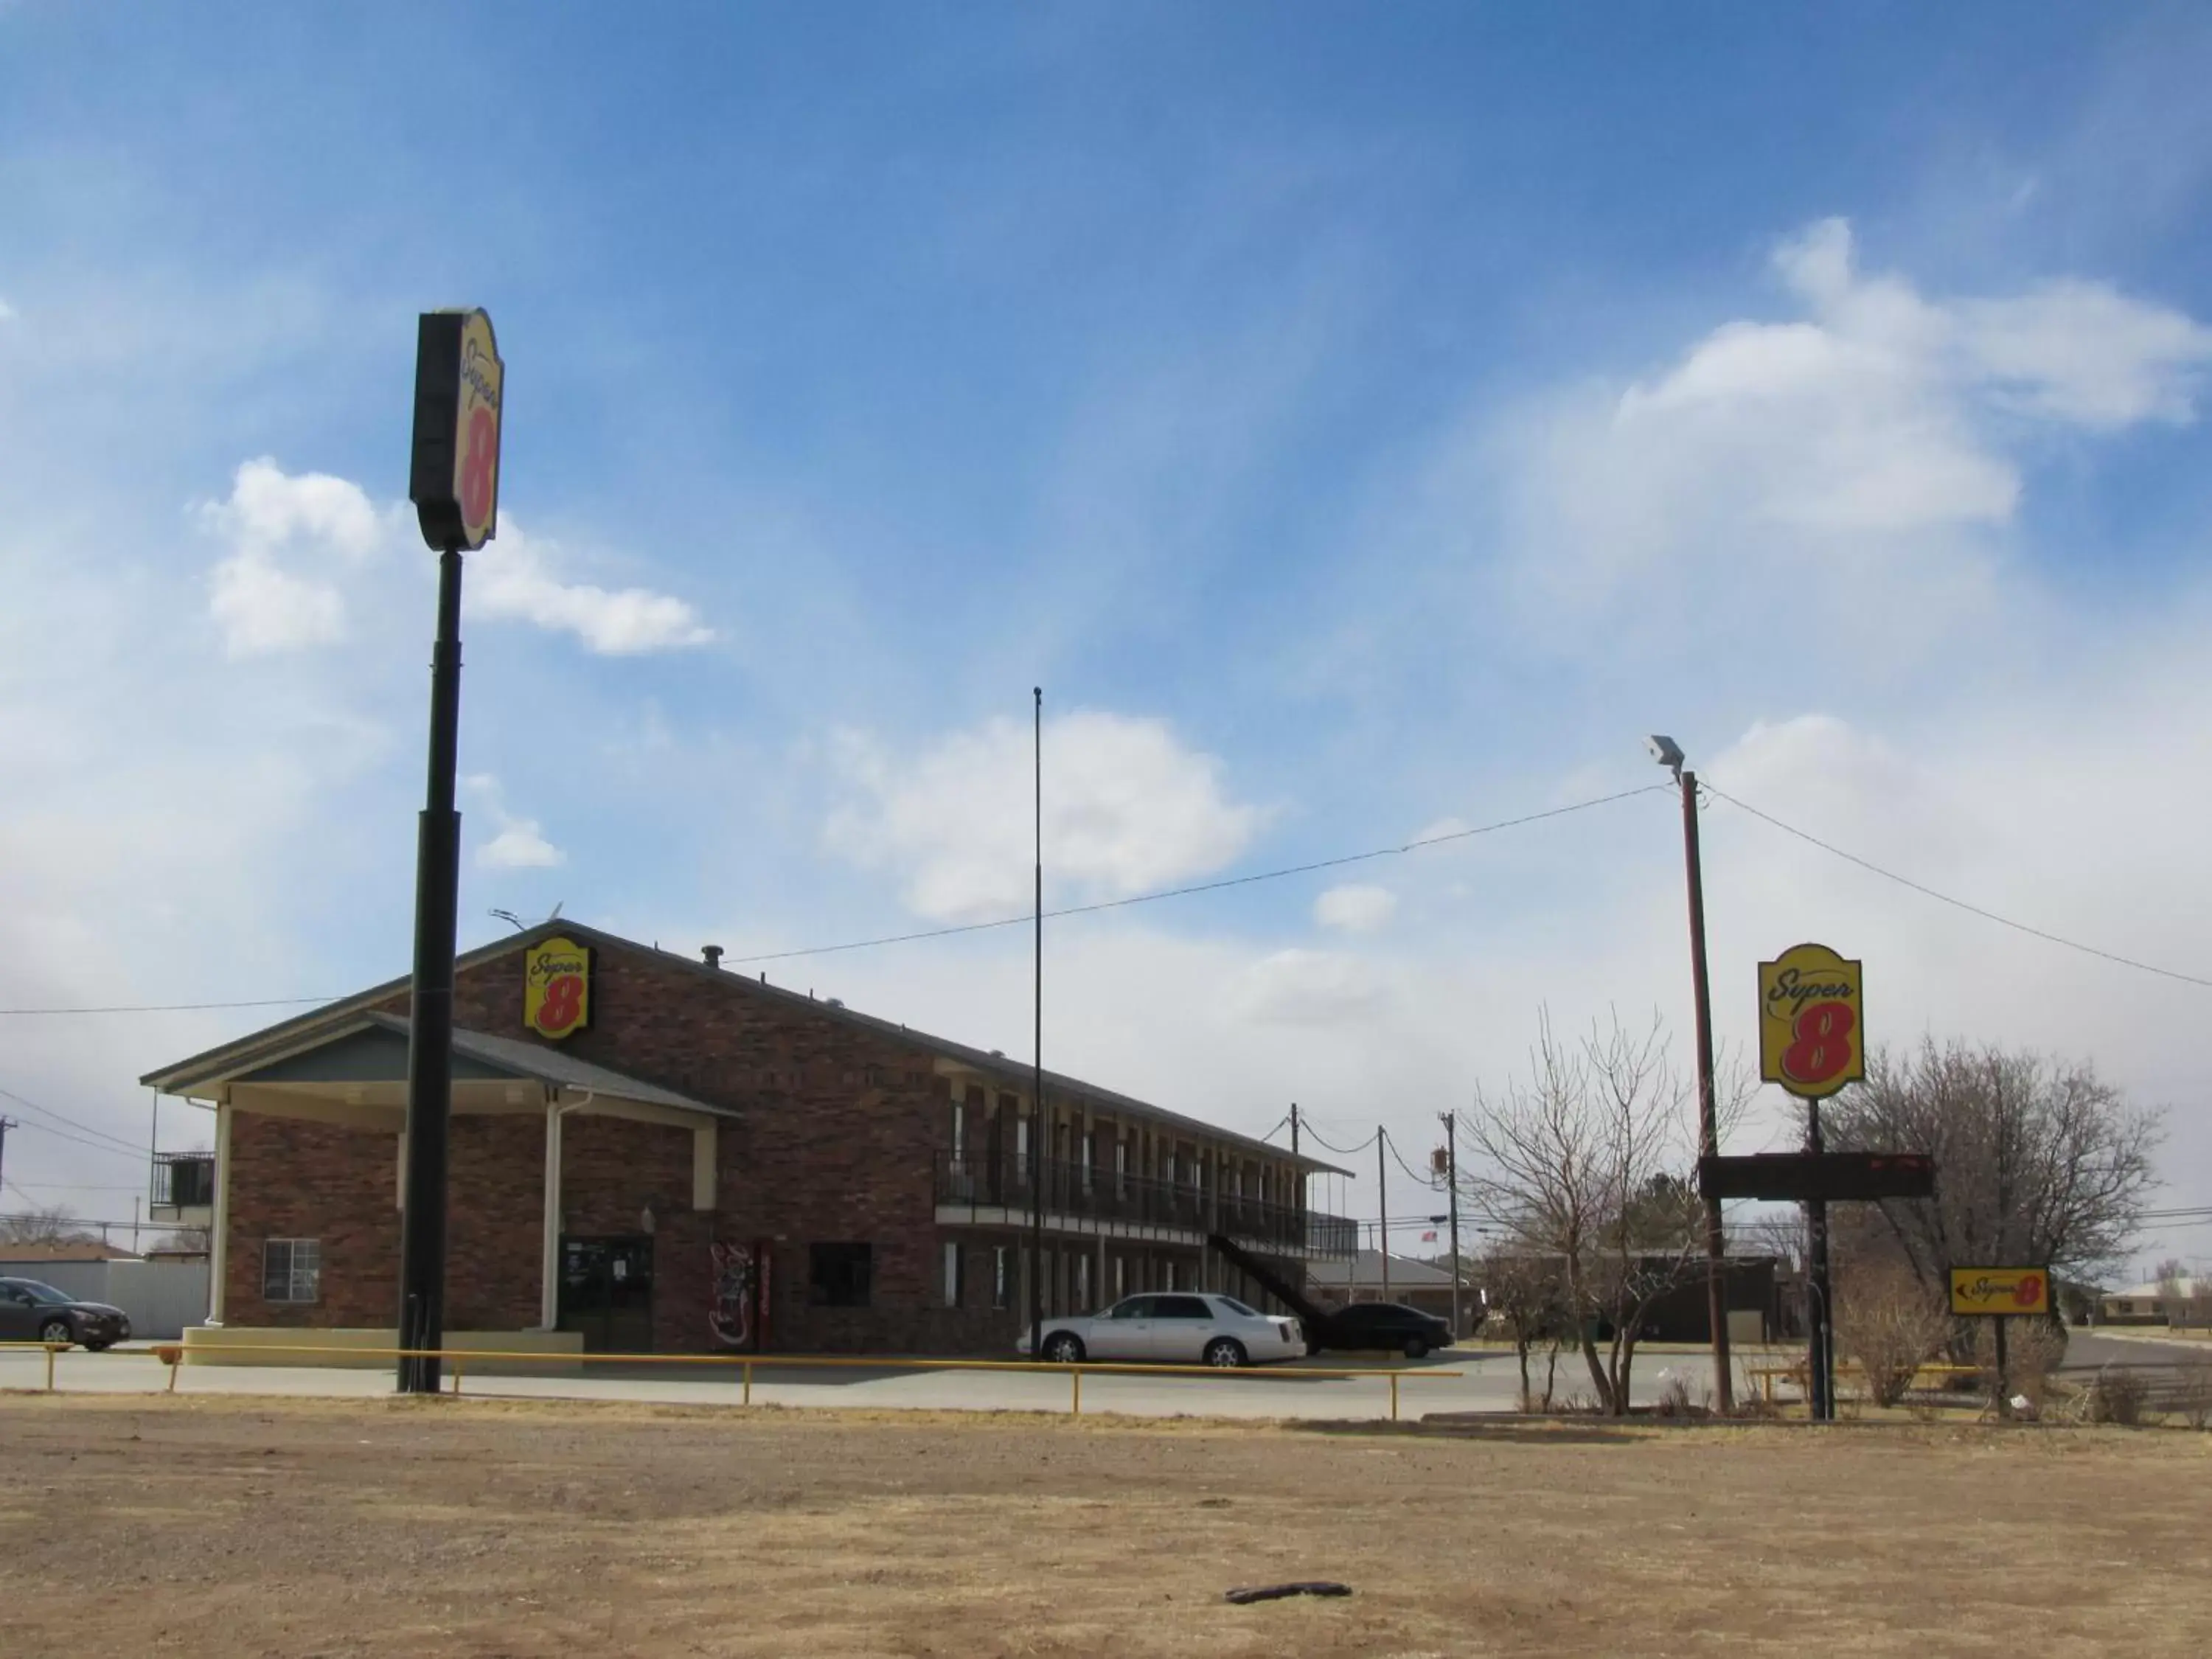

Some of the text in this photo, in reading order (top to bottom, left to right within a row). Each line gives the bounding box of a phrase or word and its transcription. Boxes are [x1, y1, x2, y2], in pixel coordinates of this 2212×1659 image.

[460, 337, 498, 411] Super
[462, 407, 495, 529] 8
[529, 952, 584, 987] Super
[1767, 967, 1854, 1022] Super
[535, 974, 585, 1032] 8
[1779, 1001, 1855, 1085] 8
[2012, 1275, 2042, 1307] 8
